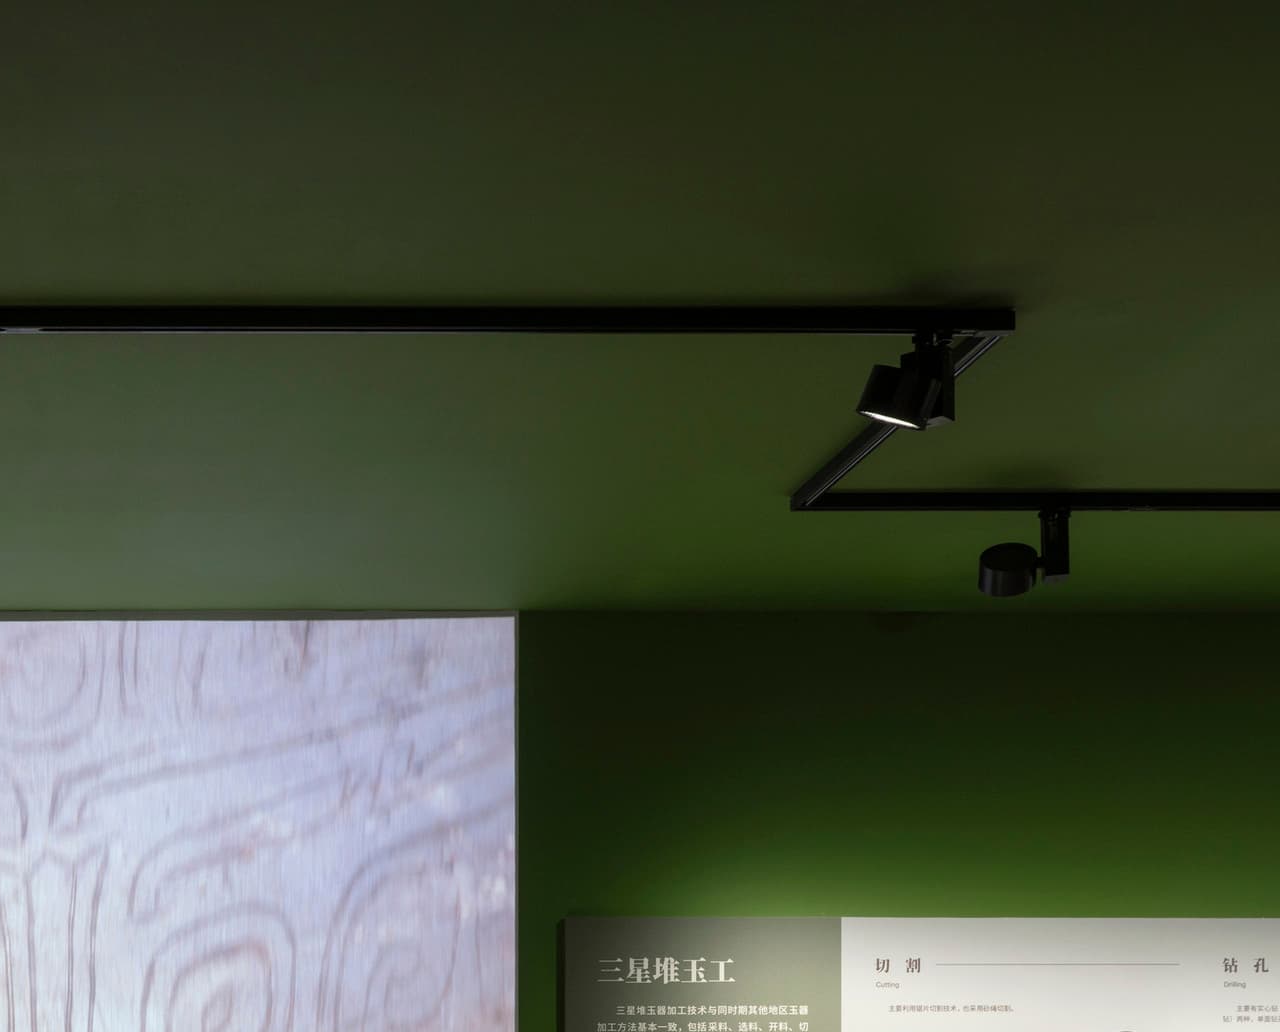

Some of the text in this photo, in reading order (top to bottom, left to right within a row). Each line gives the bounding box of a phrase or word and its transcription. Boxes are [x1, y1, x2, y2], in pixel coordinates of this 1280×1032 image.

[597, 957, 736, 985] 三星堆玉工
[875, 957, 921, 973] 切割
[1223, 957, 1269, 973] 钻孔
[875, 981, 900, 989] Cutting
[616, 1005, 809, 1016] 三星堆玉器加工技术与同时期其他地区玉器
